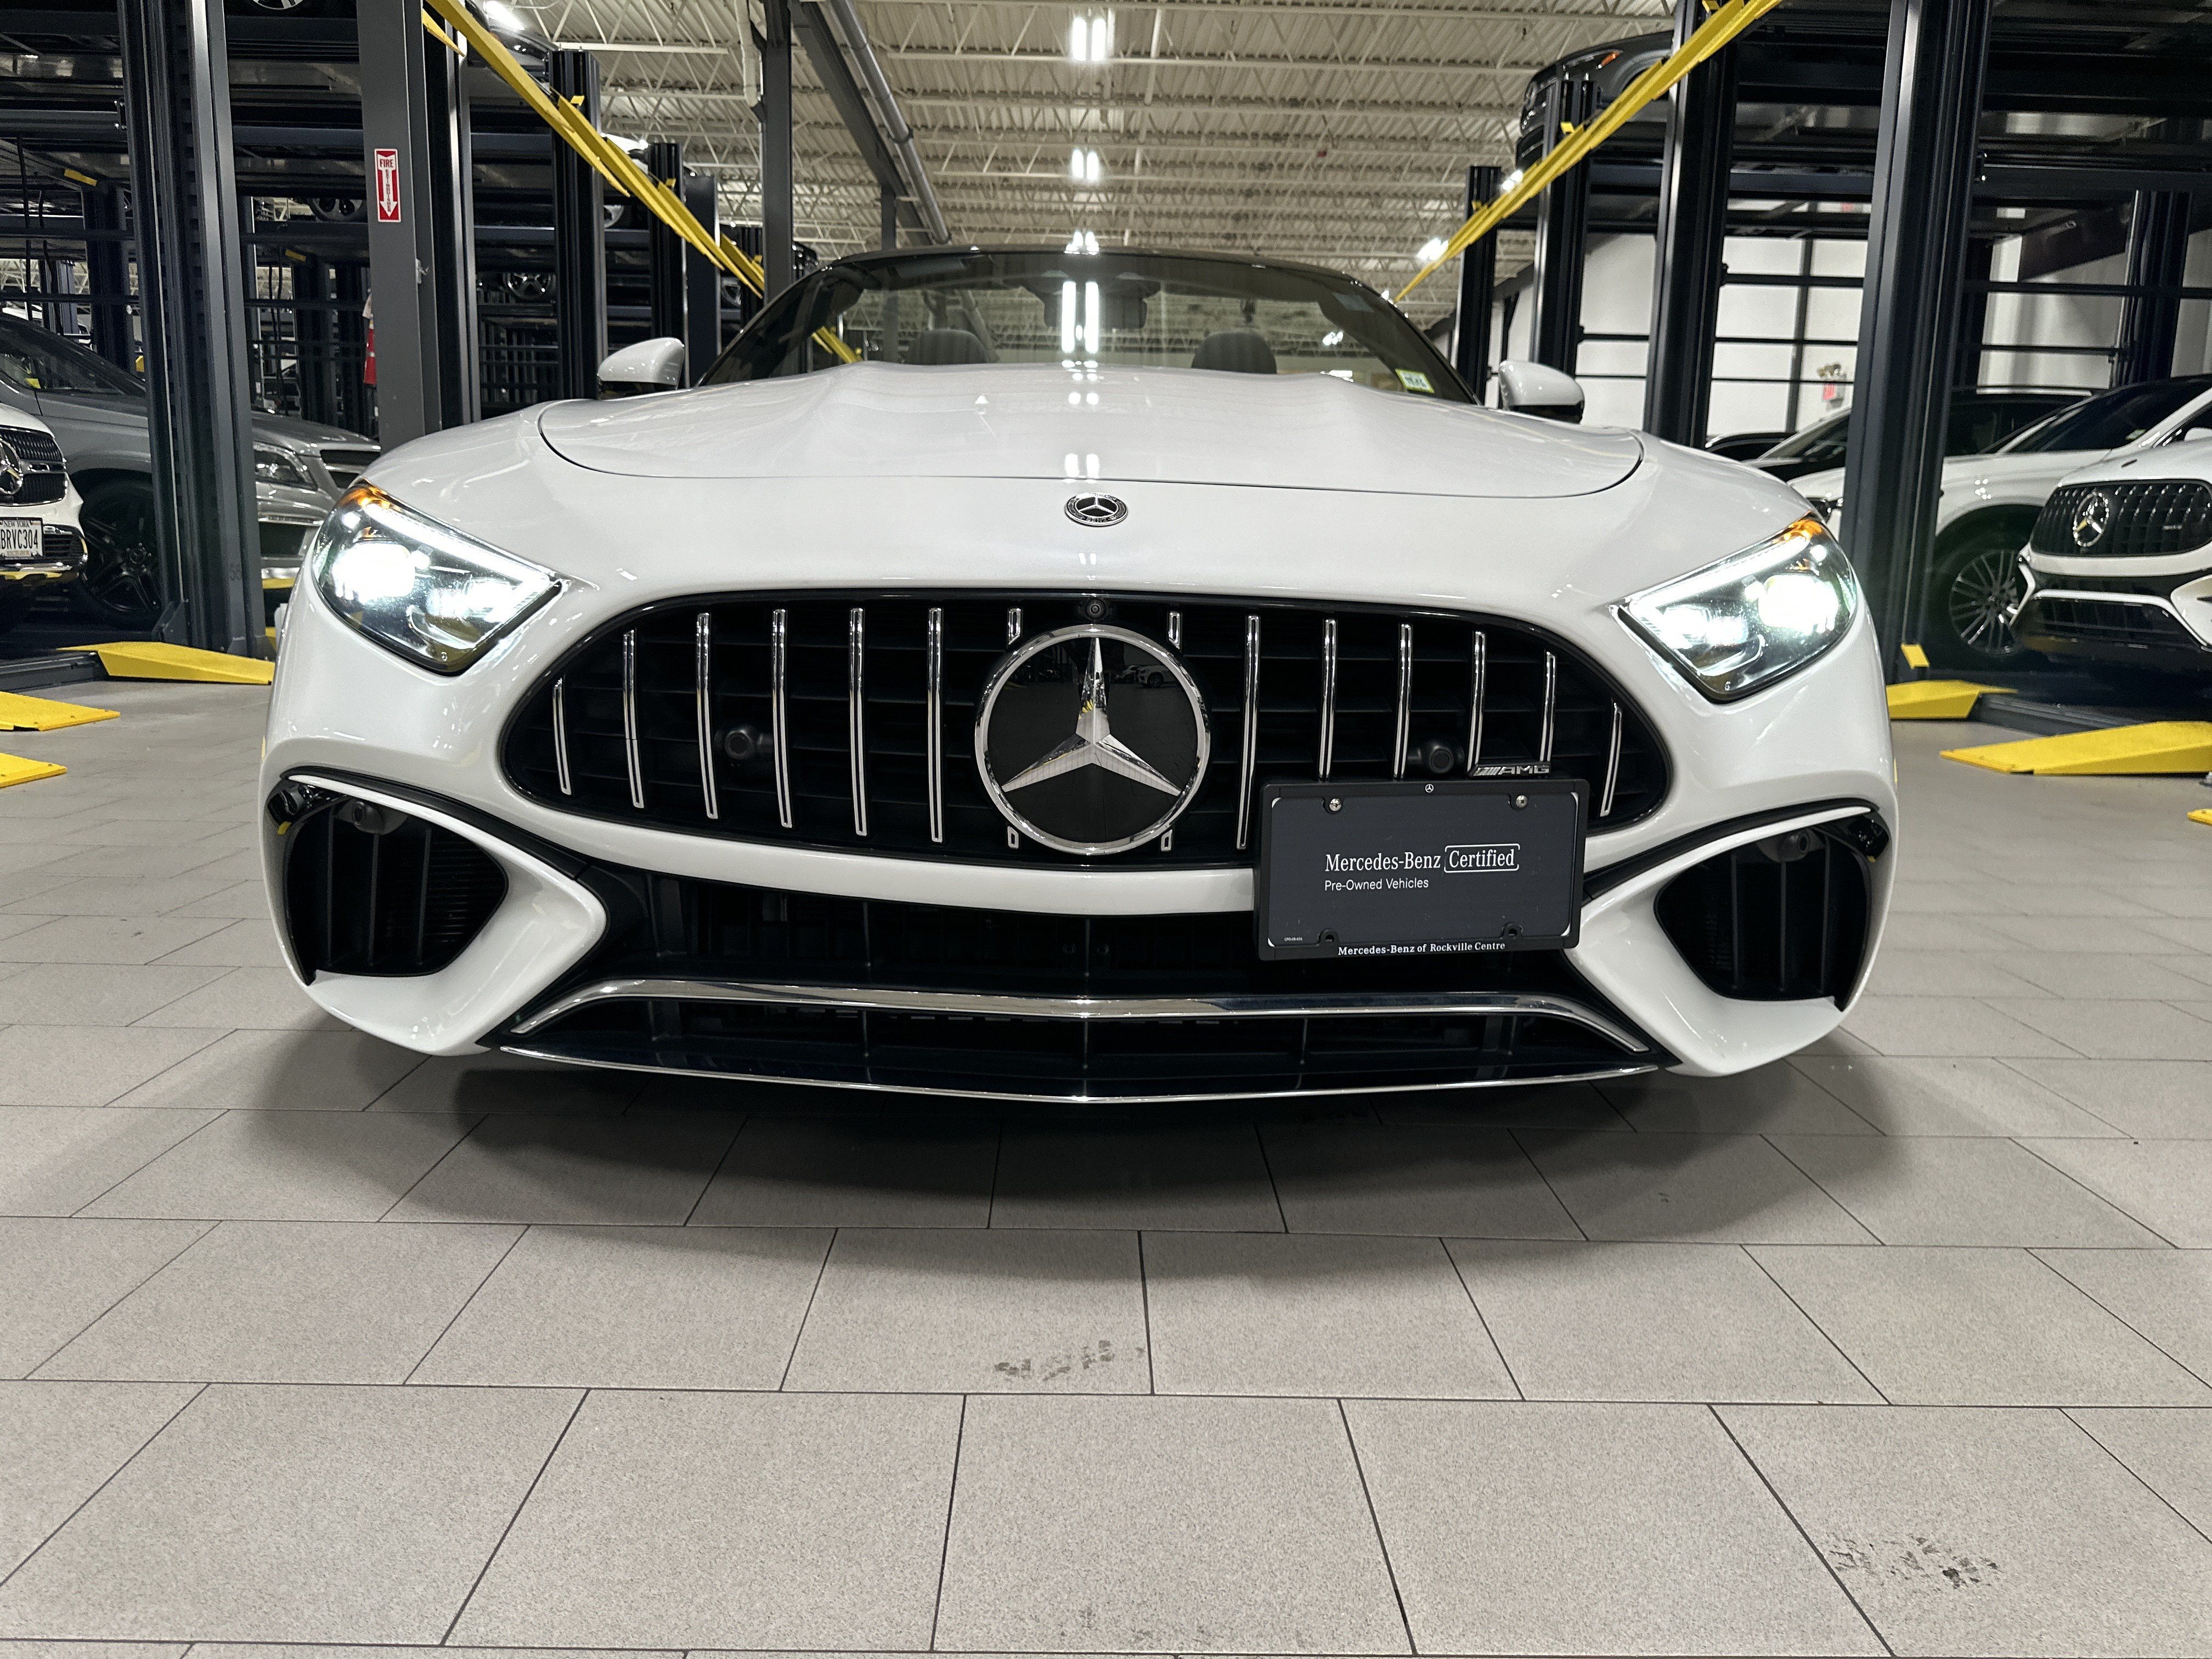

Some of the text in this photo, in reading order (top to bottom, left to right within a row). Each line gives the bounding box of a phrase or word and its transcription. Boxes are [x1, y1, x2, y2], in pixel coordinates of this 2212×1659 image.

[380, 159, 394, 168] FIRE
[0, 529, 38, 549] BRVC304
[1498, 765, 1549, 775] AMG
[1325, 849, 1515, 872] Mercedes-Benz Certified
[1324, 877, 1429, 891] Pre-Owned Vehicles
[1338, 942, 1505, 956] Mercedes-Benz of Rockville Centre
